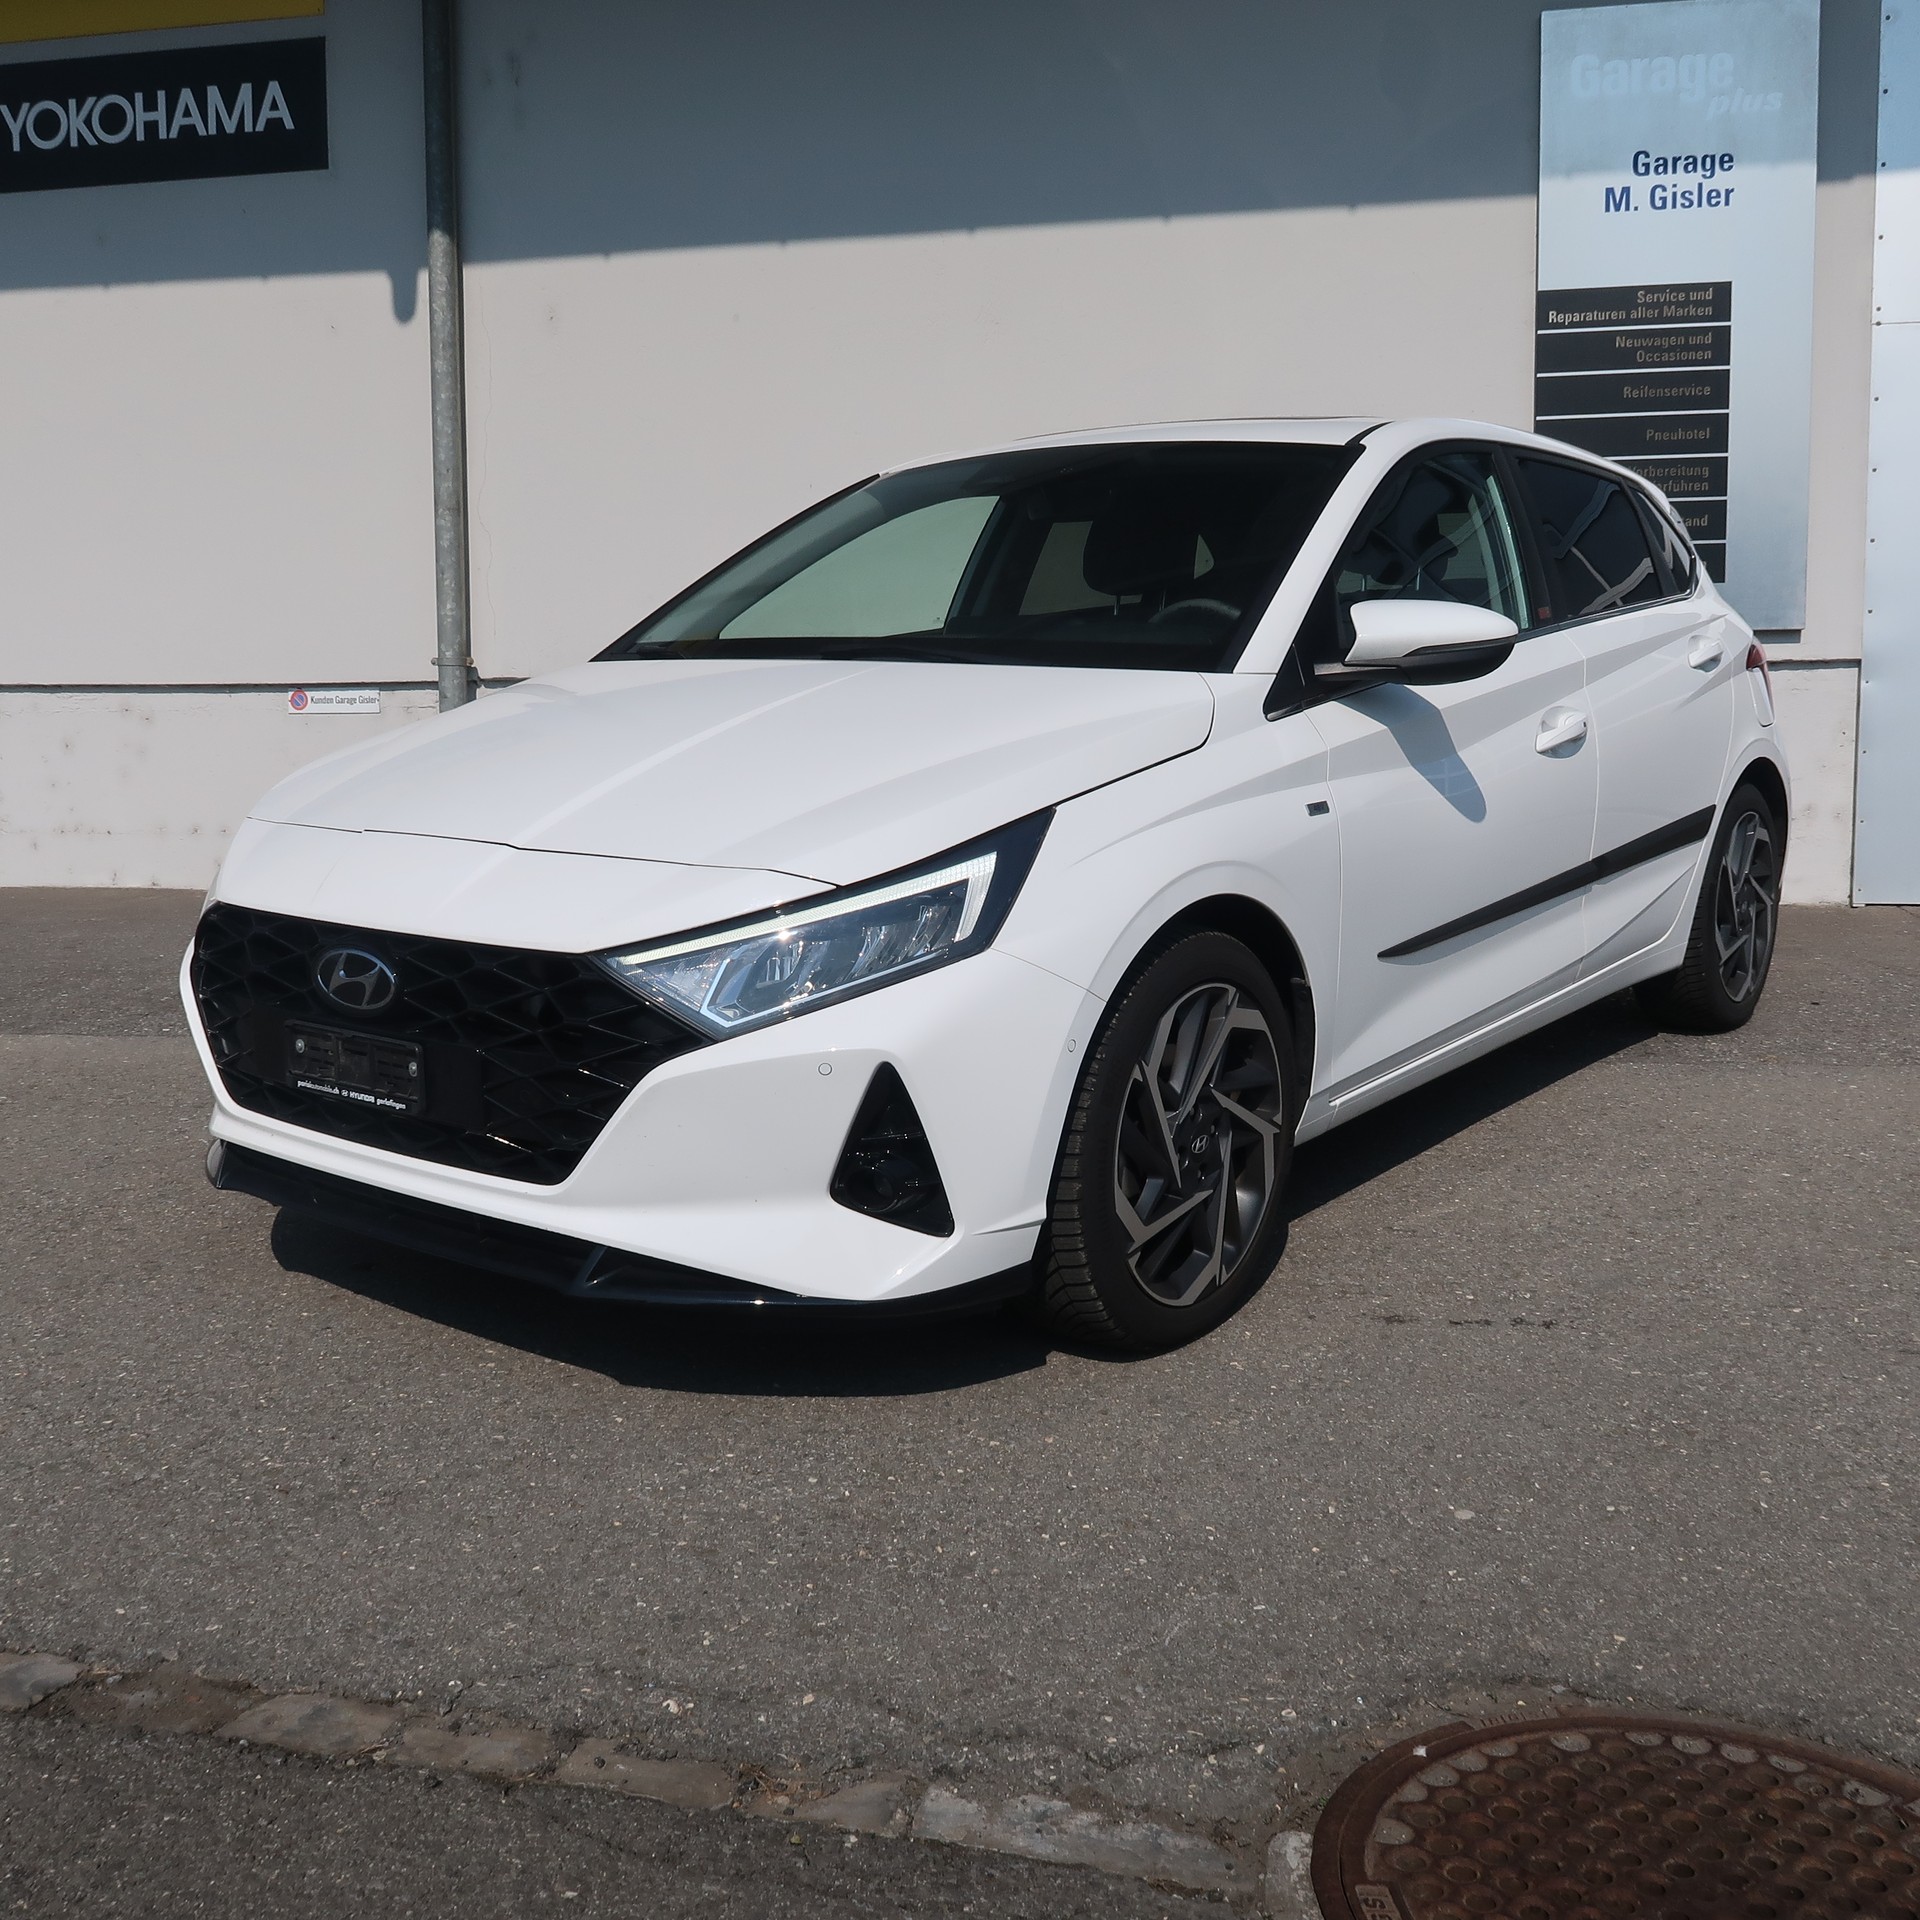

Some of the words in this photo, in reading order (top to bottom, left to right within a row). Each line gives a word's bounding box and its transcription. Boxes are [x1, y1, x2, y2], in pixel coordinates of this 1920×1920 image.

[1570, 52, 1735, 102] Garage
[1706, 88, 1784, 121] plus
[0, 80, 295, 152] YOKOHAMA
[1632, 150, 1735, 179] Garage
[1604, 186, 1640, 213] M.
[1649, 182, 1735, 211] Gisler
[1637, 289, 1685, 304] Service
[1689, 287, 1713, 301] und
[1548, 309, 1626, 325] Reparaturen
[1630, 307, 1659, 320] aller
[1663, 304, 1713, 318] Marken
[1615, 333, 1685, 350] Neuwagen
[1689, 332, 1713, 345] und
[1636, 349, 1712, 363] Occasionen
[1623, 384, 1711, 399] Reifenservice
[1646, 427, 1710, 441] Pneuhotel
[310, 695, 334, 704] Kunden
[335, 695, 357, 706] Garage
[358, 695, 377, 705] Gisler
